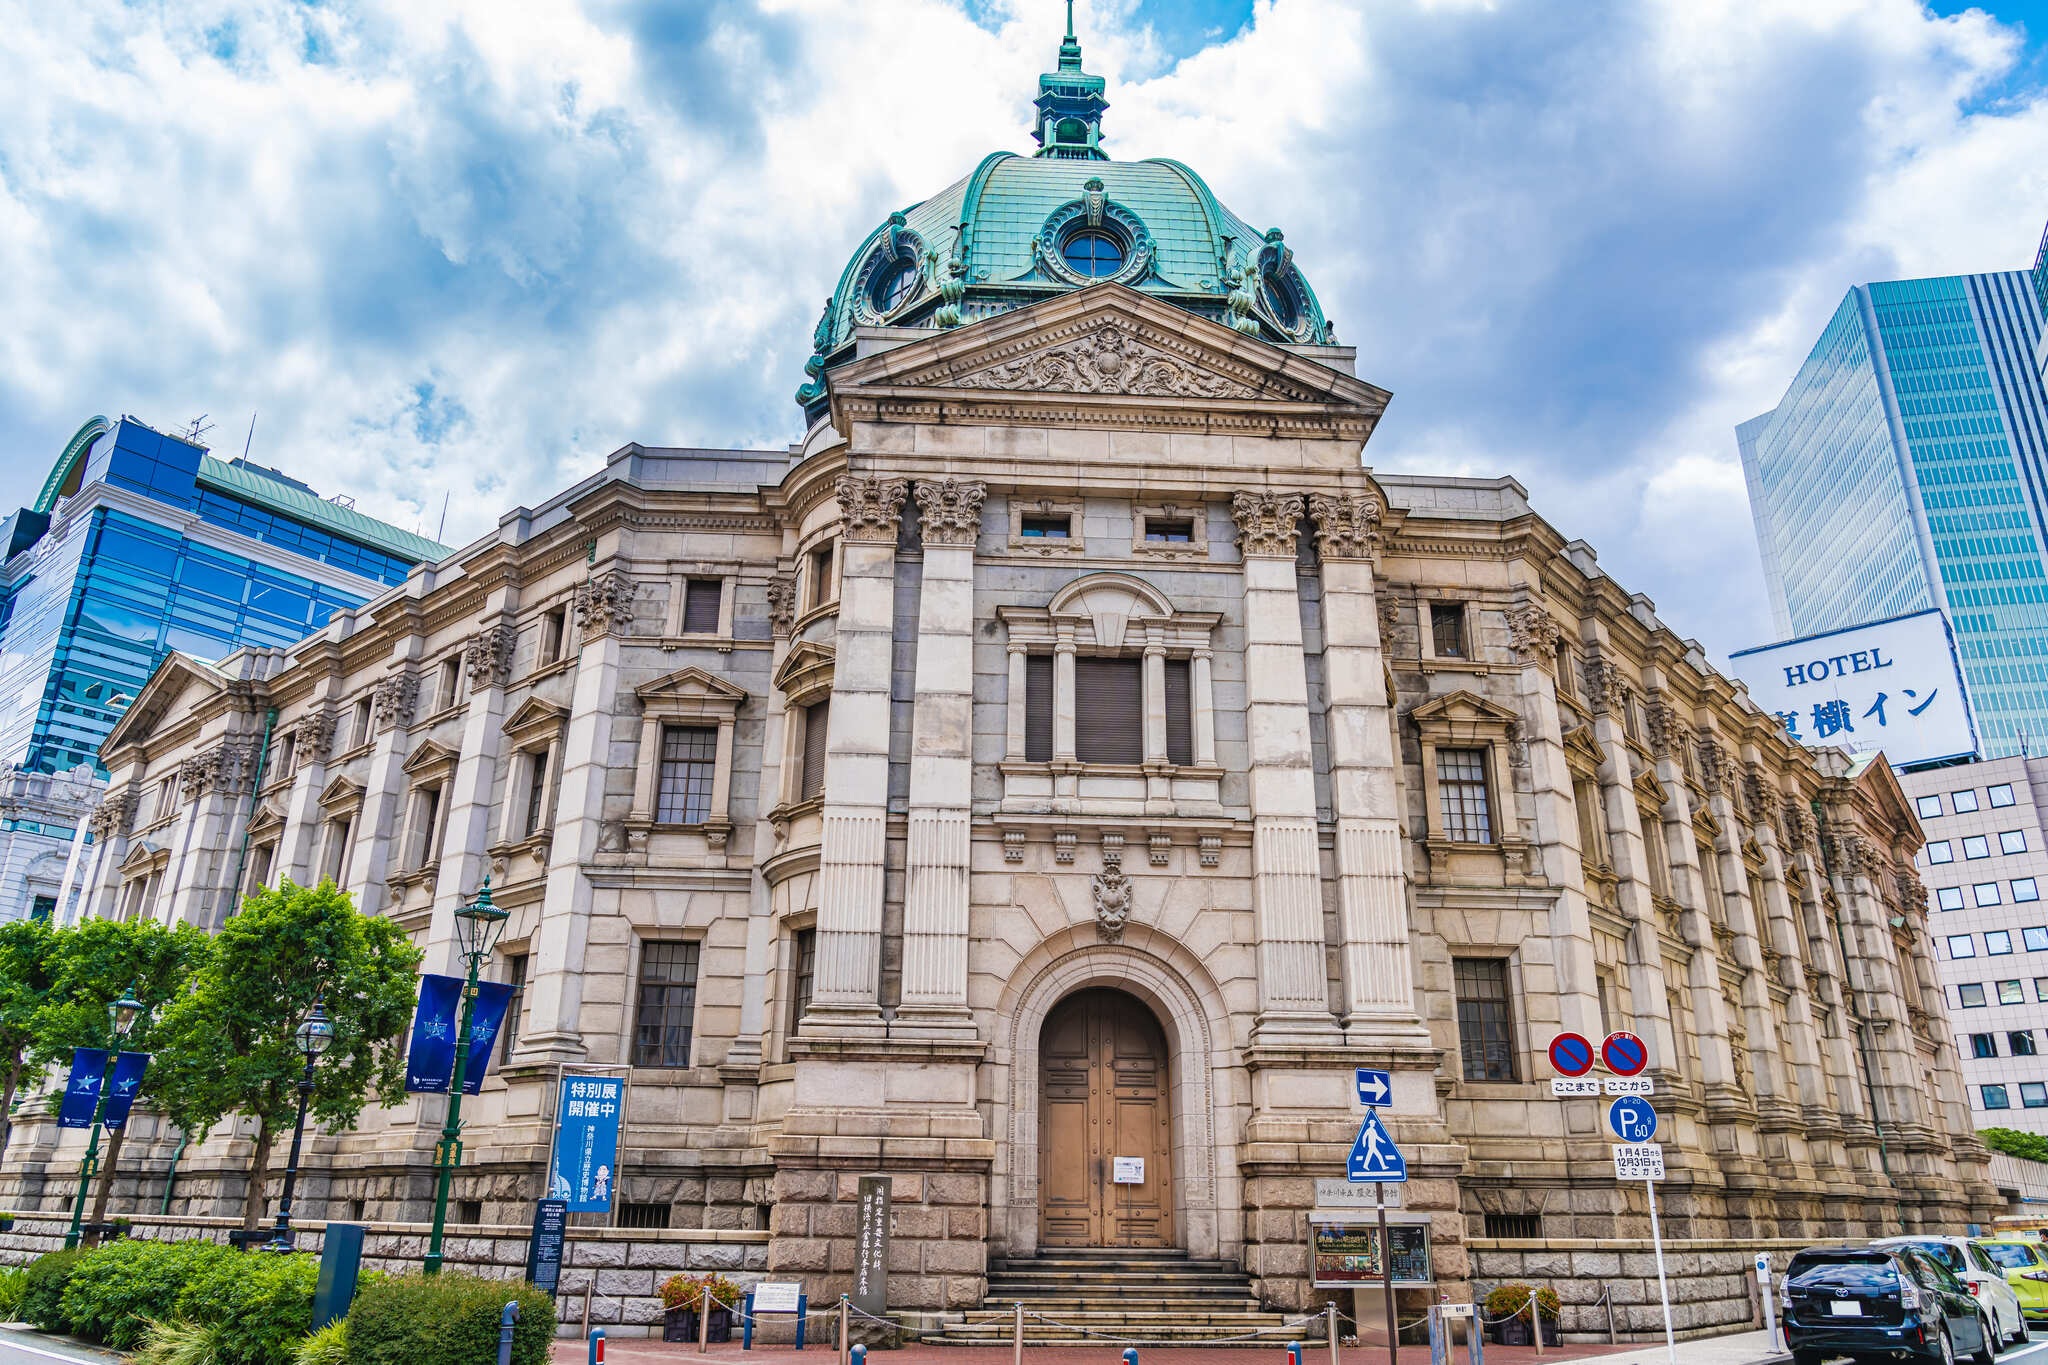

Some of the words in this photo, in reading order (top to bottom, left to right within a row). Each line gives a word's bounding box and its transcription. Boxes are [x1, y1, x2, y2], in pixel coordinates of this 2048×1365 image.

[1784, 648, 1893, 687] HOTEL
[571, 1081, 617, 1099] 特別展
[1555, 1082, 1596, 1092] ここまで
[1608, 1081, 1650, 1091] ここから
[568, 1101, 615, 1118] 開催中
[1620, 1108, 1638, 1138] P
[1635, 1124, 1648, 1138] 60
[579, 1125, 595, 1203] 神奈川県立歴史博物館
[1617, 1158, 1662, 1167] 12月31日まで
[1620, 1168, 1661, 1176] ここから
